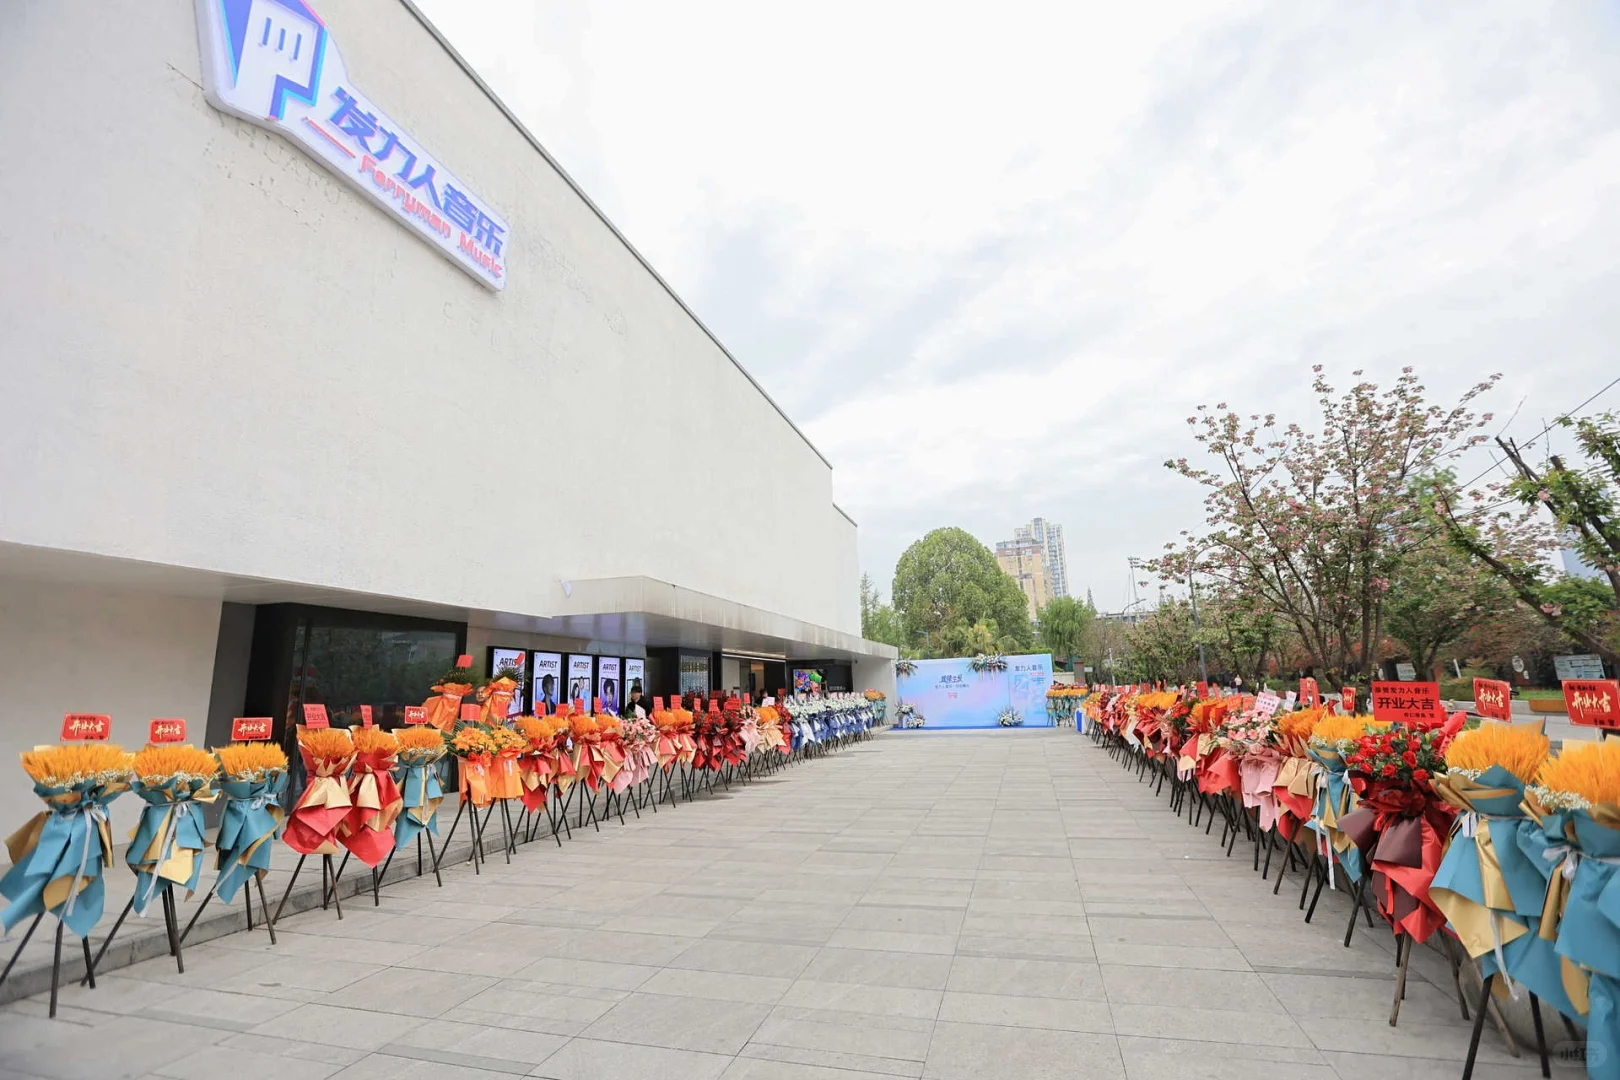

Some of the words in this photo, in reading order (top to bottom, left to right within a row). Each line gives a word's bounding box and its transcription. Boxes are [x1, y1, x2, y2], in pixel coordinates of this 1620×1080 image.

[328, 86, 506, 257] 发力人音乐
[358, 154, 452, 239] Ferryman
[457, 232, 503, 278] Music
[538, 659, 558, 669] ARTIST
[573, 661, 590, 669] ARTIST
[602, 663, 617, 671] ARTIST
[628, 664, 642, 672] ARTIST
[1378, 697, 1436, 710] 开业大吉
[1571, 690, 1612, 719] 开业大吉
